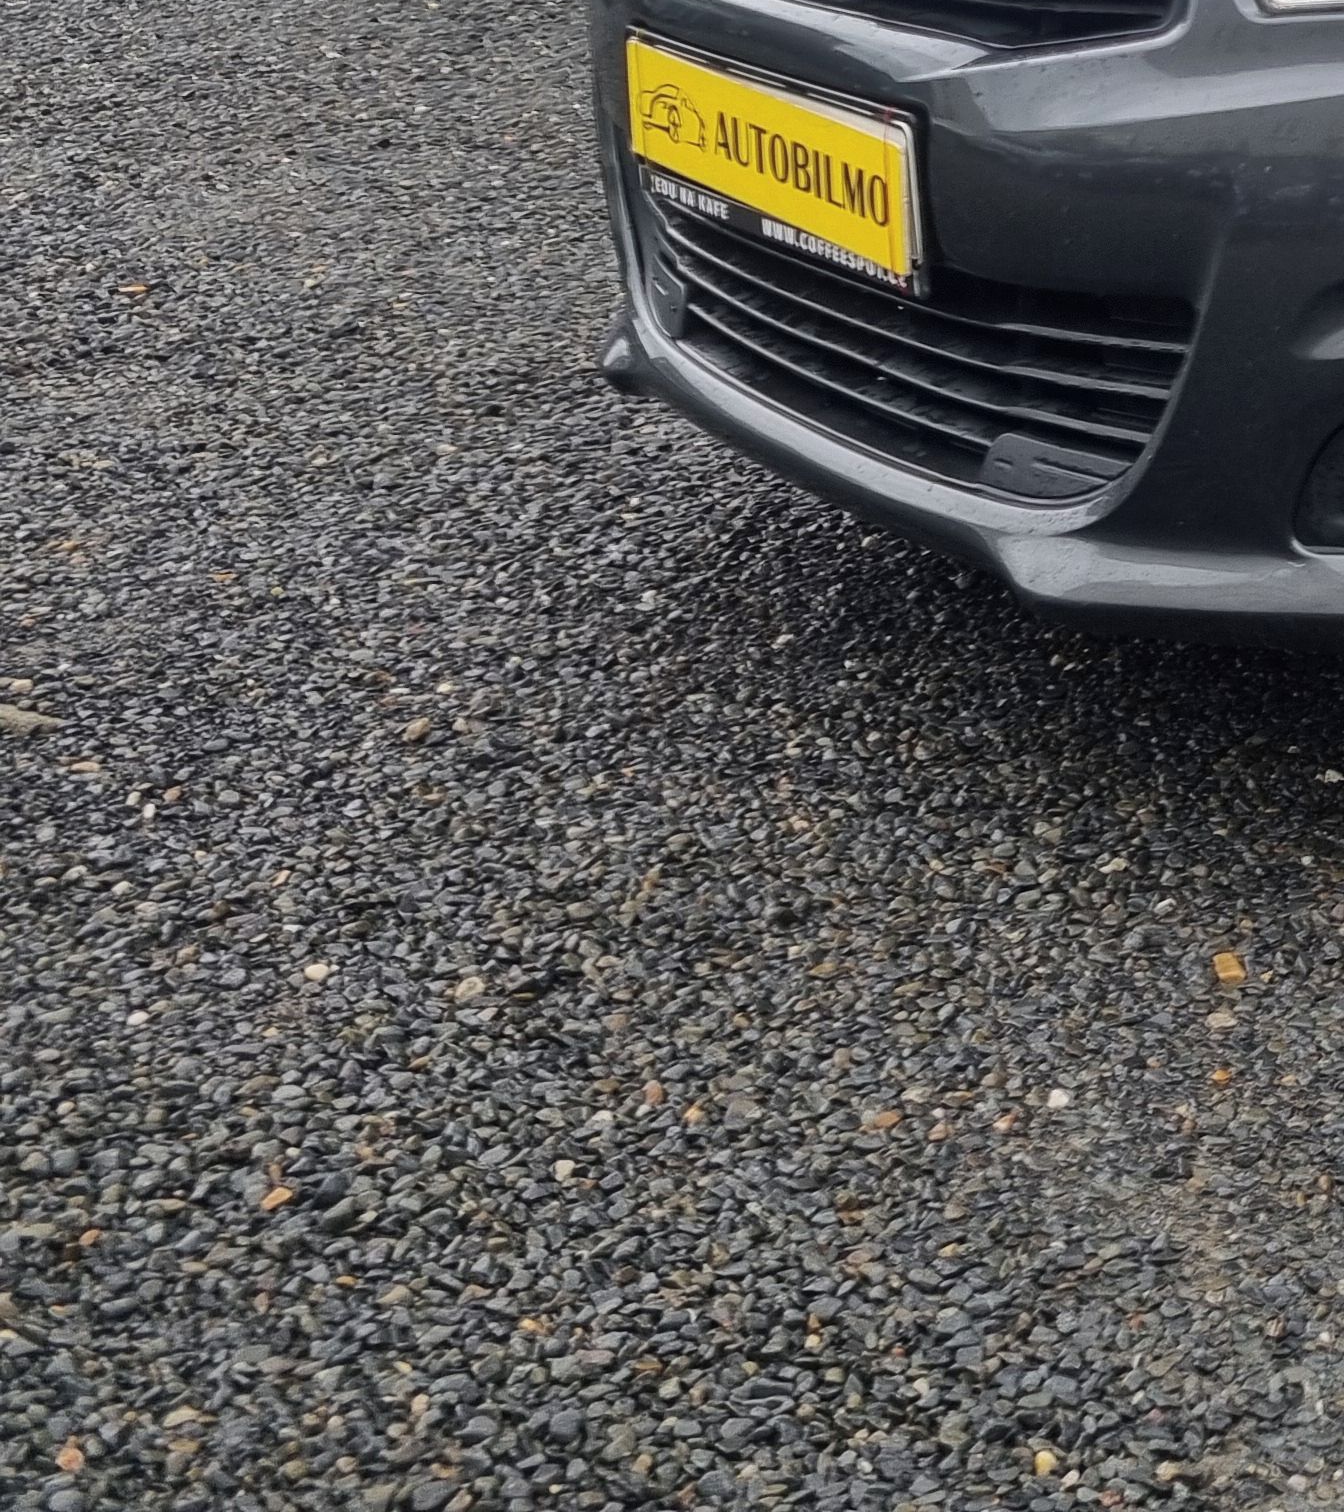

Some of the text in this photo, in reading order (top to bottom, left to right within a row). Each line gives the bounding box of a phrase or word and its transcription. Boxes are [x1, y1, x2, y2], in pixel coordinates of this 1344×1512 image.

[680, 186, 697, 208] NA
[698, 194, 730, 220] KAFE
[714, 111, 890, 227] AUTOBILMO
